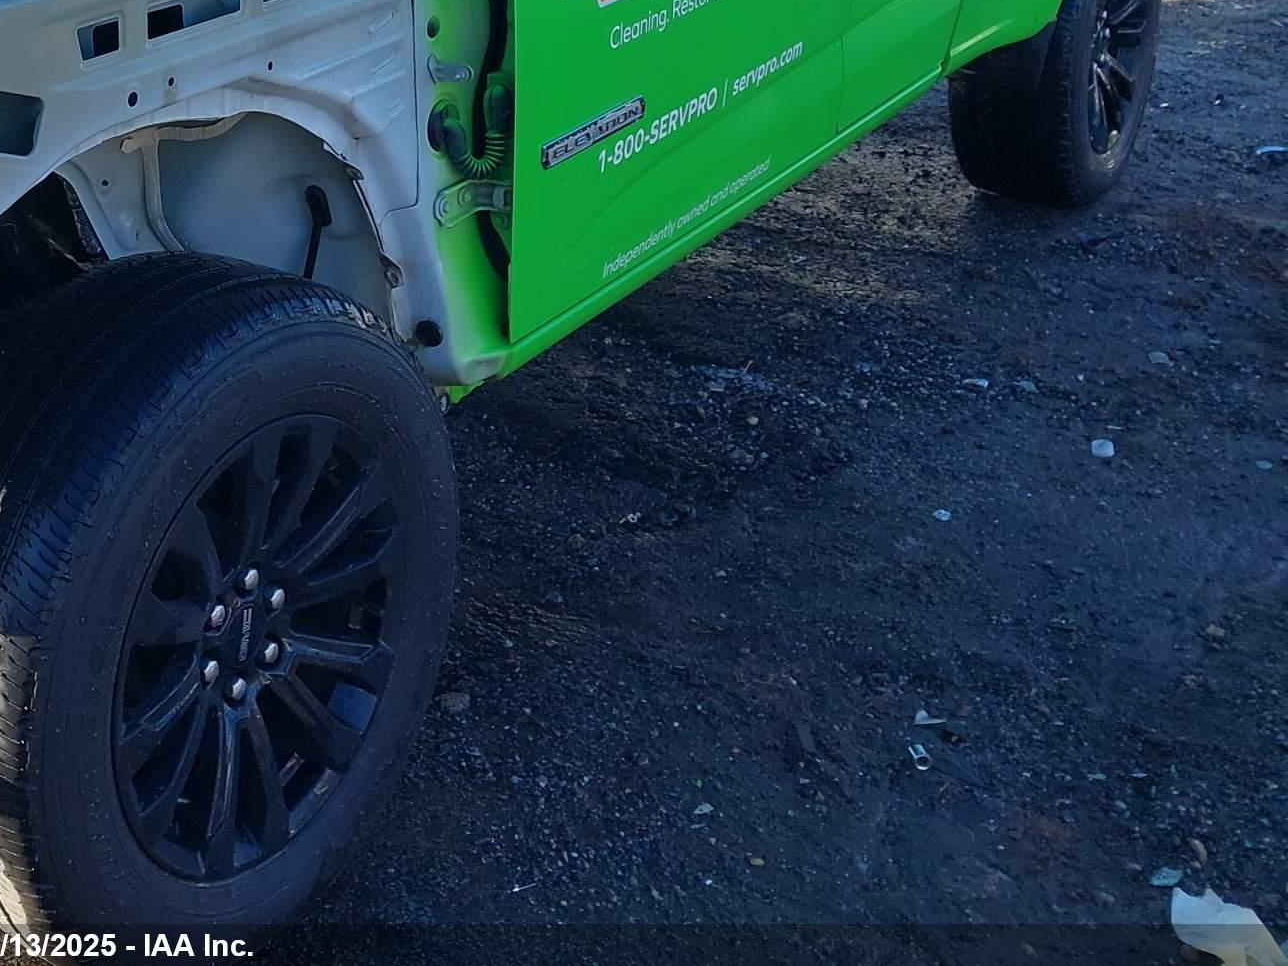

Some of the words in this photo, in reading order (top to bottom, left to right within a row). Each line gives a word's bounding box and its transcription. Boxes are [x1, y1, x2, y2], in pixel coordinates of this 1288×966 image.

[609, 9, 670, 49] Cleaning.
[552, 105, 640, 160] ELEVATION
[598, 87, 718, 173] 1-800-SERVPRO
[732, 41, 804, 97] servpro.com
[602, 218, 677, 279] Independently
[676, 194, 710, 229] owned
[710, 181, 730, 208] and
[728, 154, 773, 196] operated
